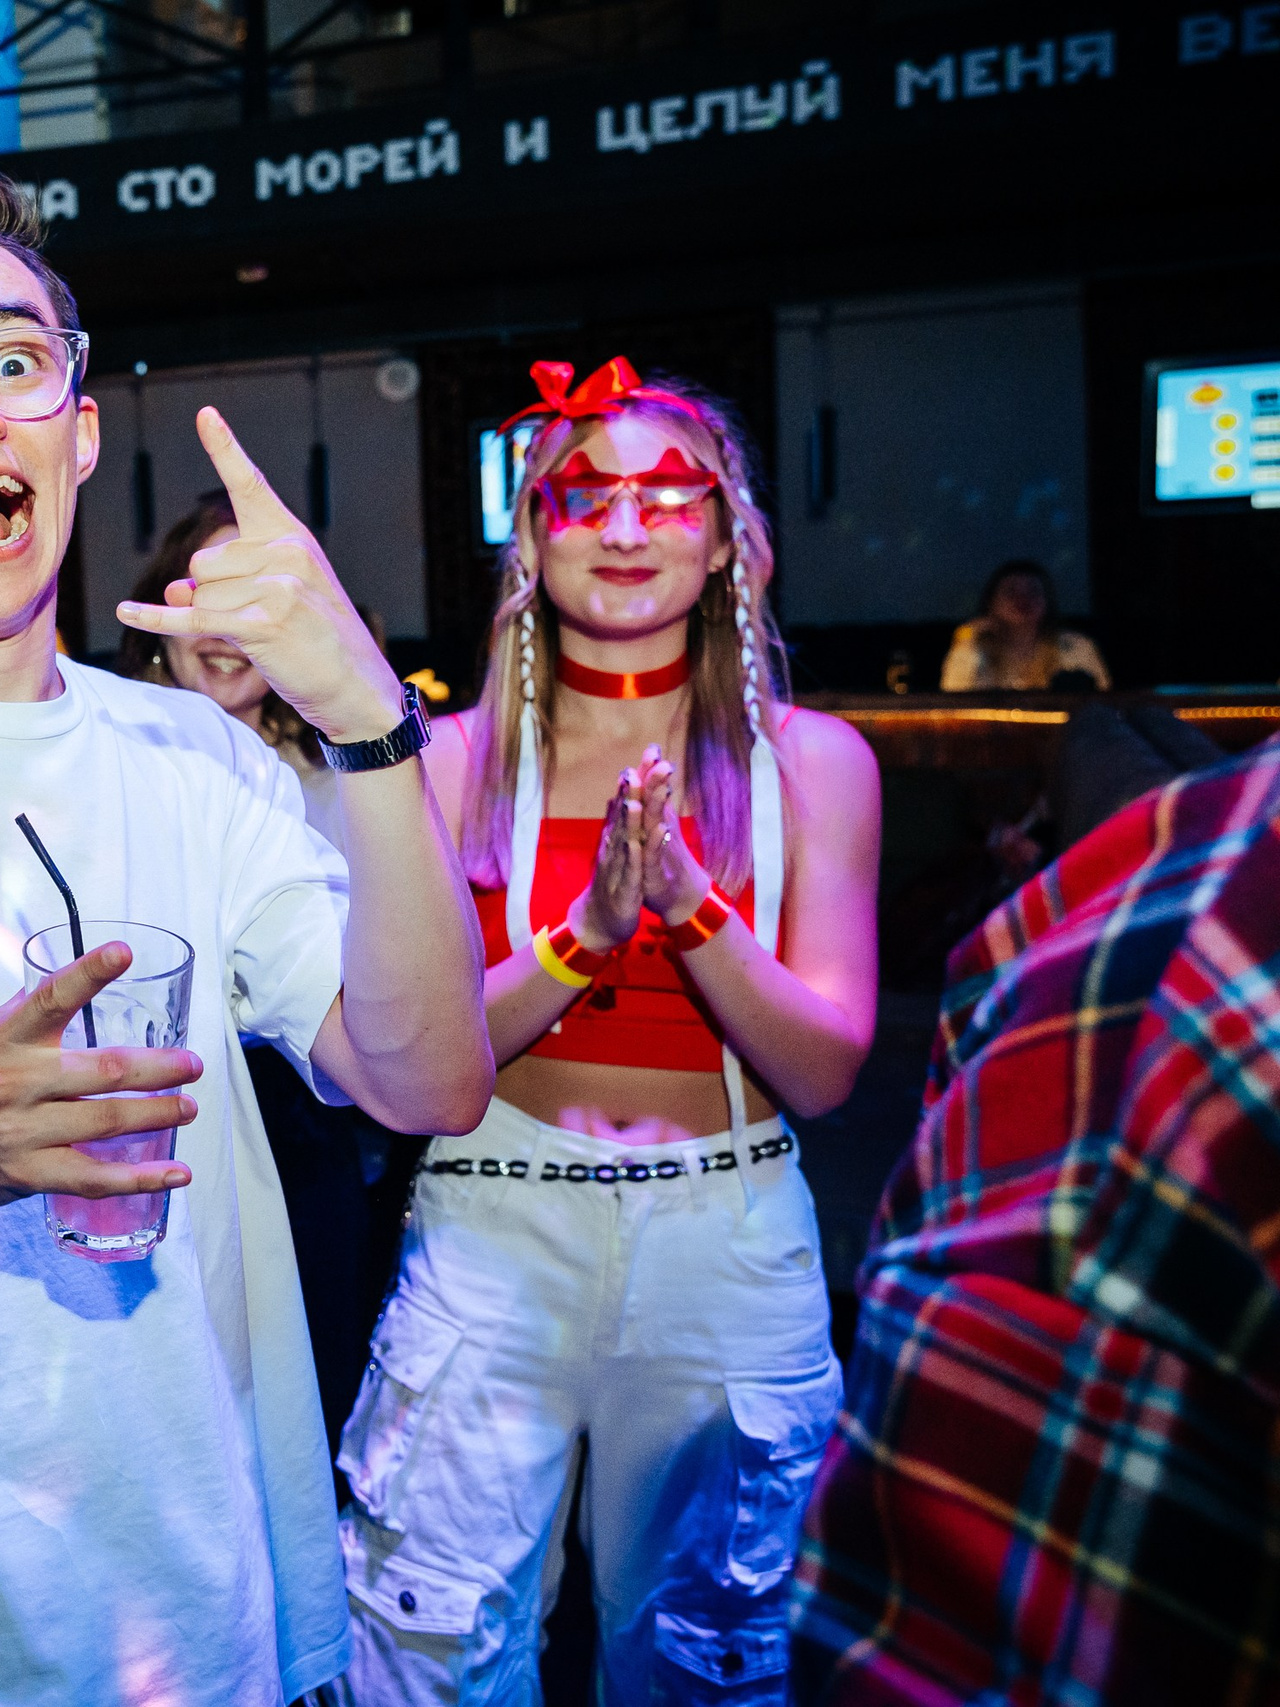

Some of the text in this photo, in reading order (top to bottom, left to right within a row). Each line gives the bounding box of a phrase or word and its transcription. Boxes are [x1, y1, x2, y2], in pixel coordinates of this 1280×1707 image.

[120, 165, 216, 213] СТО
[255, 118, 461, 200] МОРЕЙ
[505, 116, 549, 164] И
[596, 59, 841, 153] ЦЕЛУЙ
[895, 29, 1117, 107] МЕНЯ
